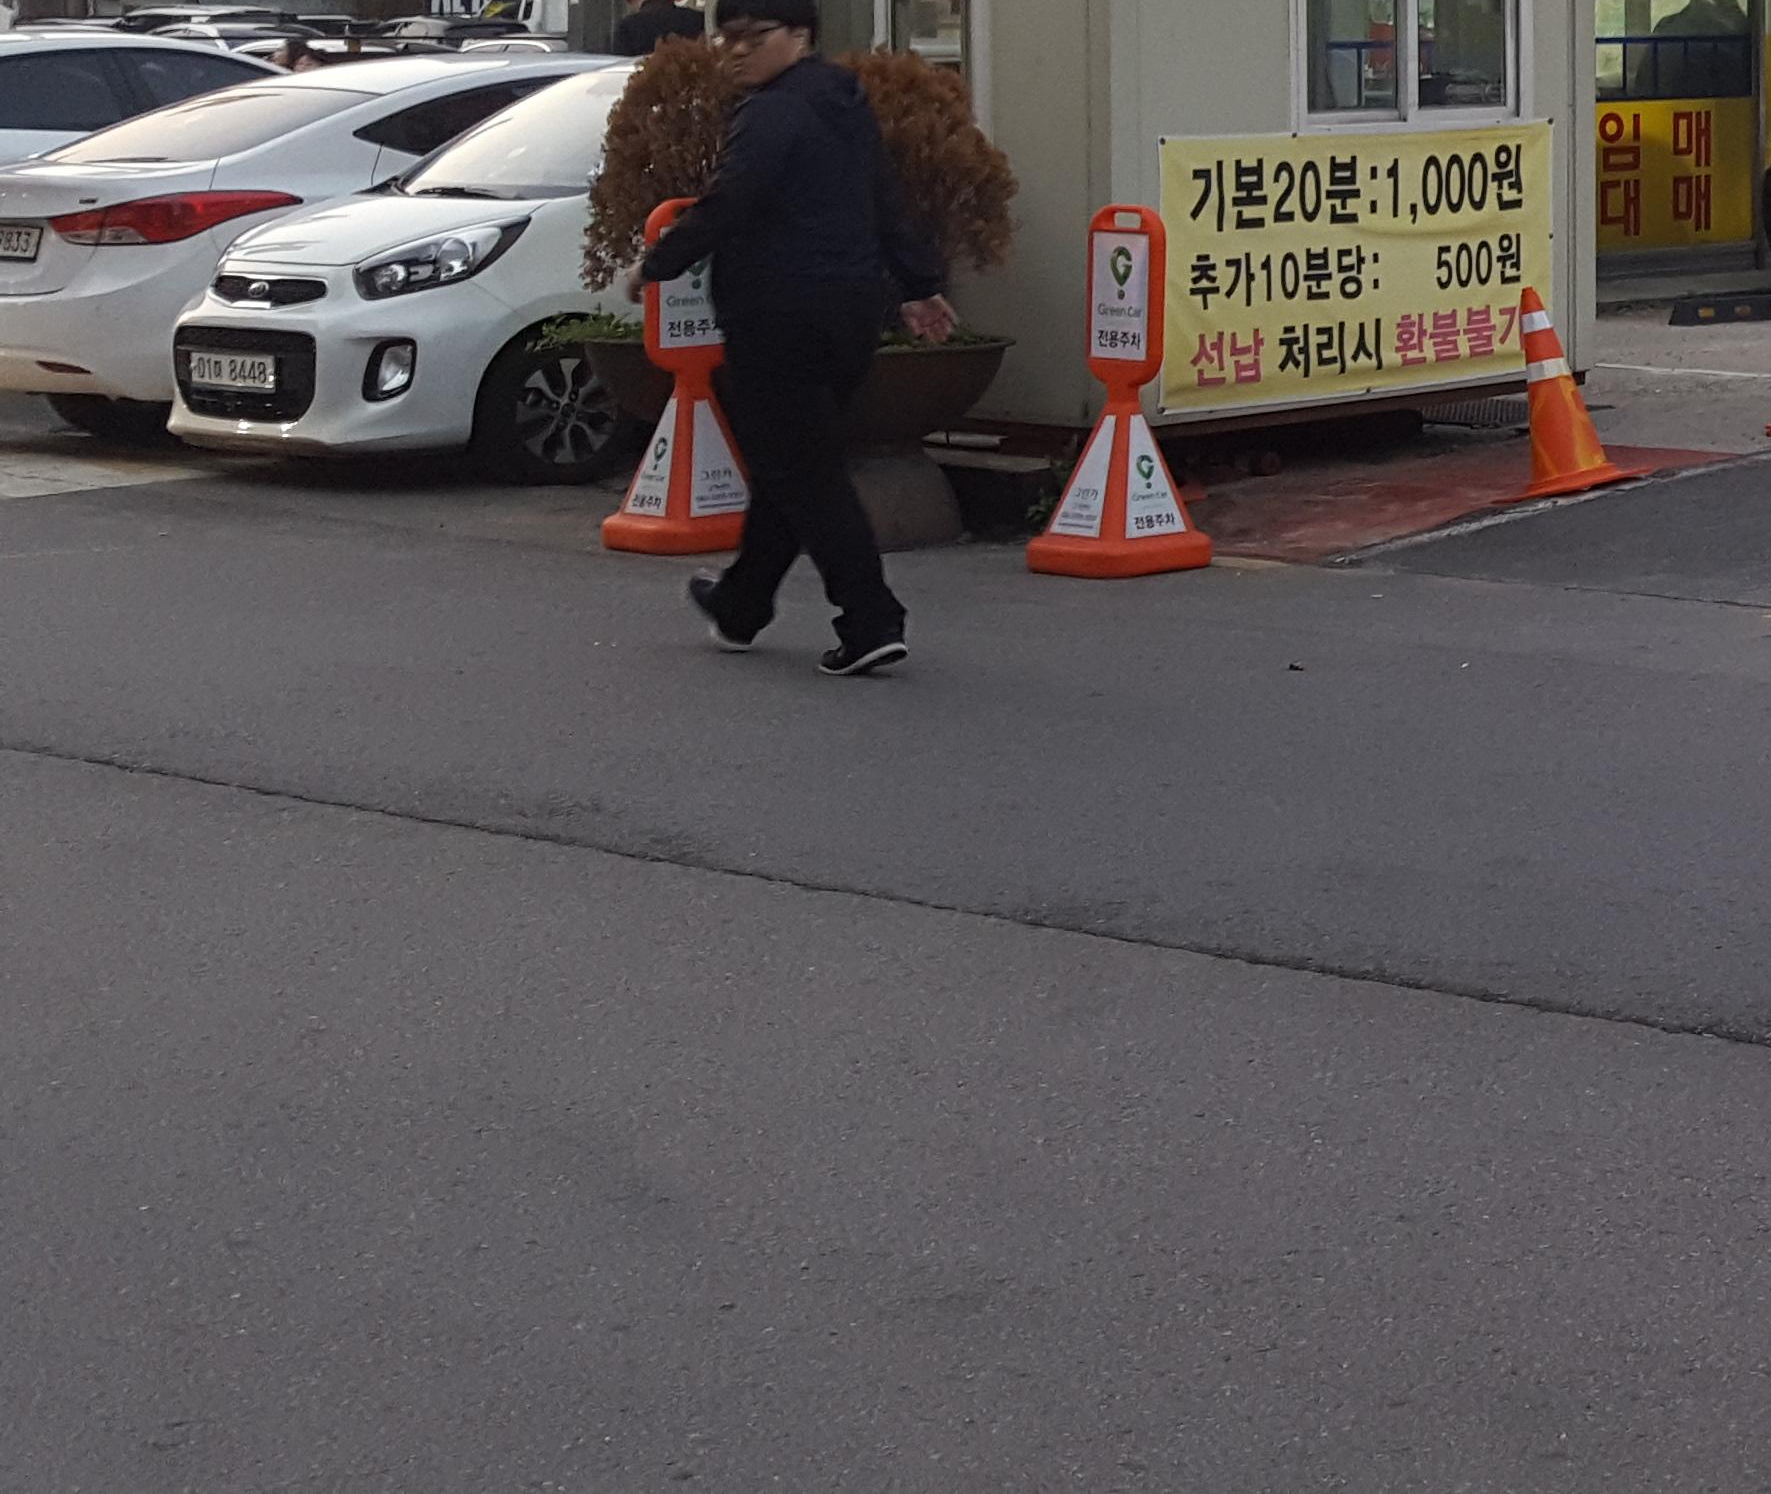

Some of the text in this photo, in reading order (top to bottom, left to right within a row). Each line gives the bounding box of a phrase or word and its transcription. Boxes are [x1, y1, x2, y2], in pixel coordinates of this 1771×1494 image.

[1436, 233, 1523, 291] 500원
[1098, 329, 1141, 350] 전용주차
[1190, 328, 1265, 388] 선납
